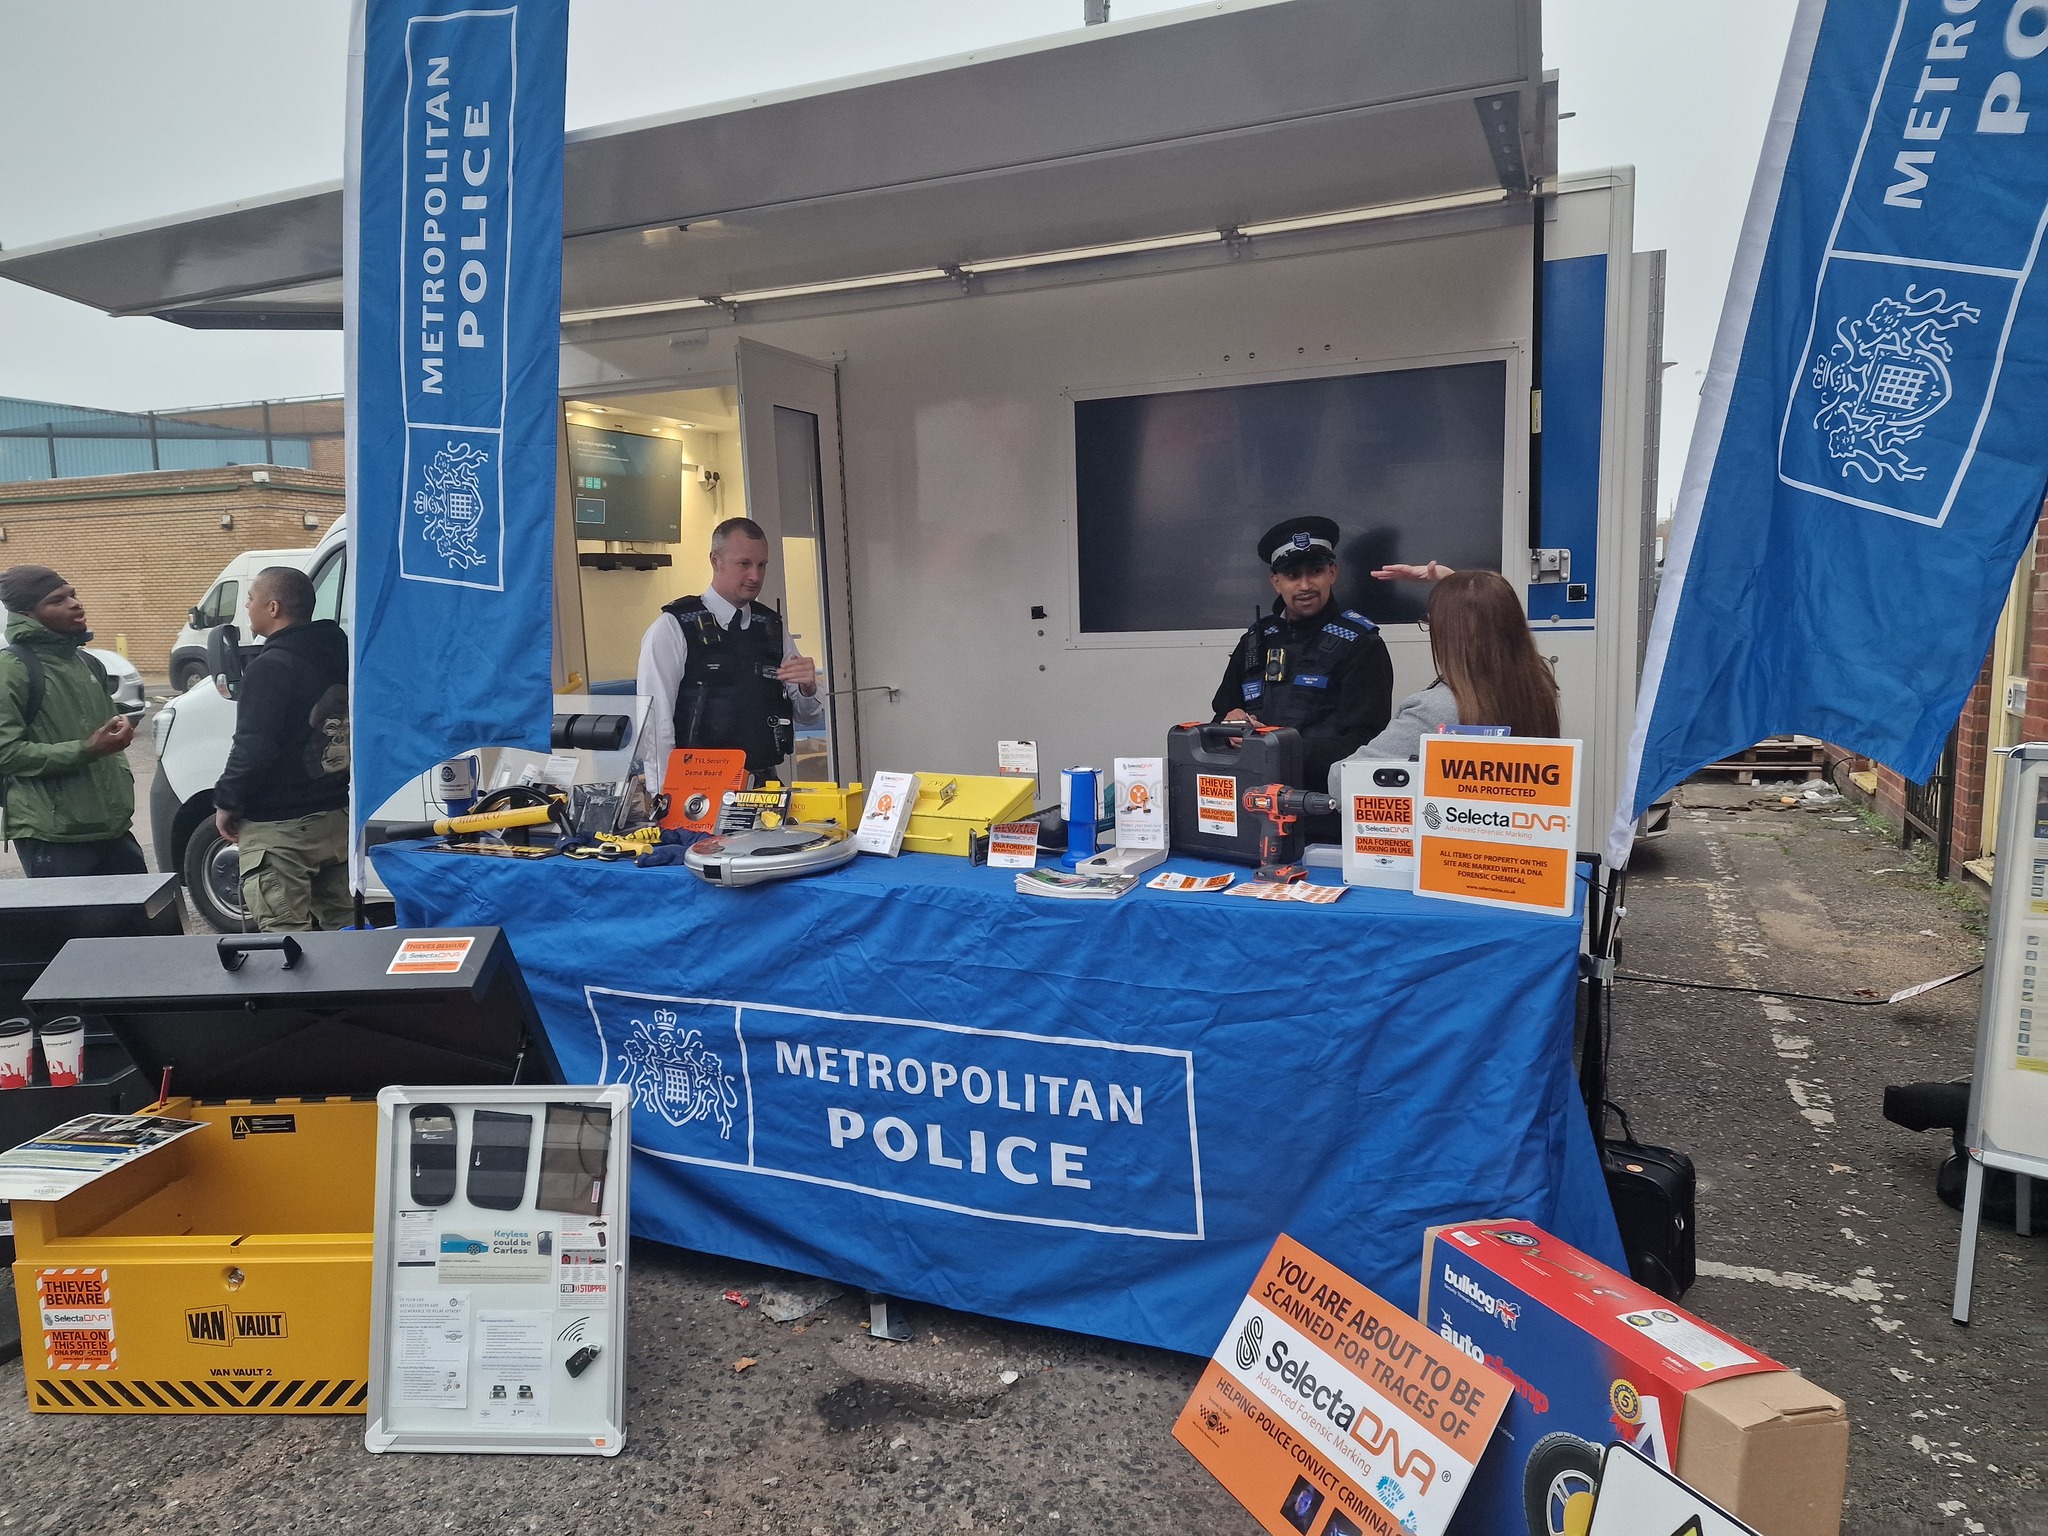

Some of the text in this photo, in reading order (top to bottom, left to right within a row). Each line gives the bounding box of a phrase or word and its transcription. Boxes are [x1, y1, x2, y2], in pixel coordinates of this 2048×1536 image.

[421, 56, 450, 394] METROPOLITAN
[457, 101, 491, 348] POLICE
[1441, 758, 1560, 786] WARNING
[1200, 777, 1233, 789] THIEVES
[1200, 787, 1233, 798] BEWARE
[1458, 784, 1536, 798] DNA PROTECTED
[736, 793, 779, 804] MILENCO
[1356, 797, 1410, 811] THIEVES
[1356, 809, 1411, 823] BEWARE
[686, 822, 714, 830] Security
[993, 826, 1036, 834] BEWARE
[1444, 825, 1533, 840] Advanced Forensic Marking
[1357, 845, 1411, 855] MARKING IN USE
[1374, 839, 1411, 847] FORENSIC
[1440, 850, 1452, 858] ALL
[1453, 851, 1472, 860] ITEMS
[1484, 855, 1519, 865] PROPERTY
[1520, 858, 1531, 866] ON
[1532, 859, 1548, 868] THIS
[1443, 859, 1457, 867] SITE
[1458, 861, 1471, 869] ARE
[1472, 863, 1500, 872] MARKED
[1501, 865, 1519, 874] WITH
[1527, 868, 1543, 877] DNA
[1457, 870, 1527, 884] FORENSIC CHEMICAL
[775, 1040, 1143, 1125] METROPOLITAN
[827, 1107, 1092, 1190] POLICE
[493, 1230, 529, 1240] Keyless
[493, 1238, 519, 1246] could
[493, 1246, 528, 1255] Carless
[44, 1280, 102, 1293] THIEVES
[561, 1284, 573, 1293] FOB
[580, 1284, 607, 1293] STOPPER
[1444, 1264, 1496, 1315] bulldog
[45, 1293, 104, 1306] BEWARE
[187, 1310, 226, 1341] VAN
[235, 1315, 282, 1336] VAULT
[52, 1331, 107, 1341] METAL ON
[1275, 1255, 1486, 1418] YOU ARE ABOUT TO BE
[53, 1341, 108, 1350] THIS SITE IS
[1262, 1281, 1472, 1440] SCANNED FOR TRACES OF
[210, 1368, 273, 1376] VAN VAULT 2
[1621, 1394, 1630, 1408] 5
[1256, 1371, 1372, 1477] Advanced Forensic Marking
[1216, 1377, 1257, 1419] HELPING
[1255, 1412, 1292, 1450] POLICE
[1290, 1444, 1340, 1491] CONVICT
[1338, 1486, 1402, 1536] CRIMINAL
